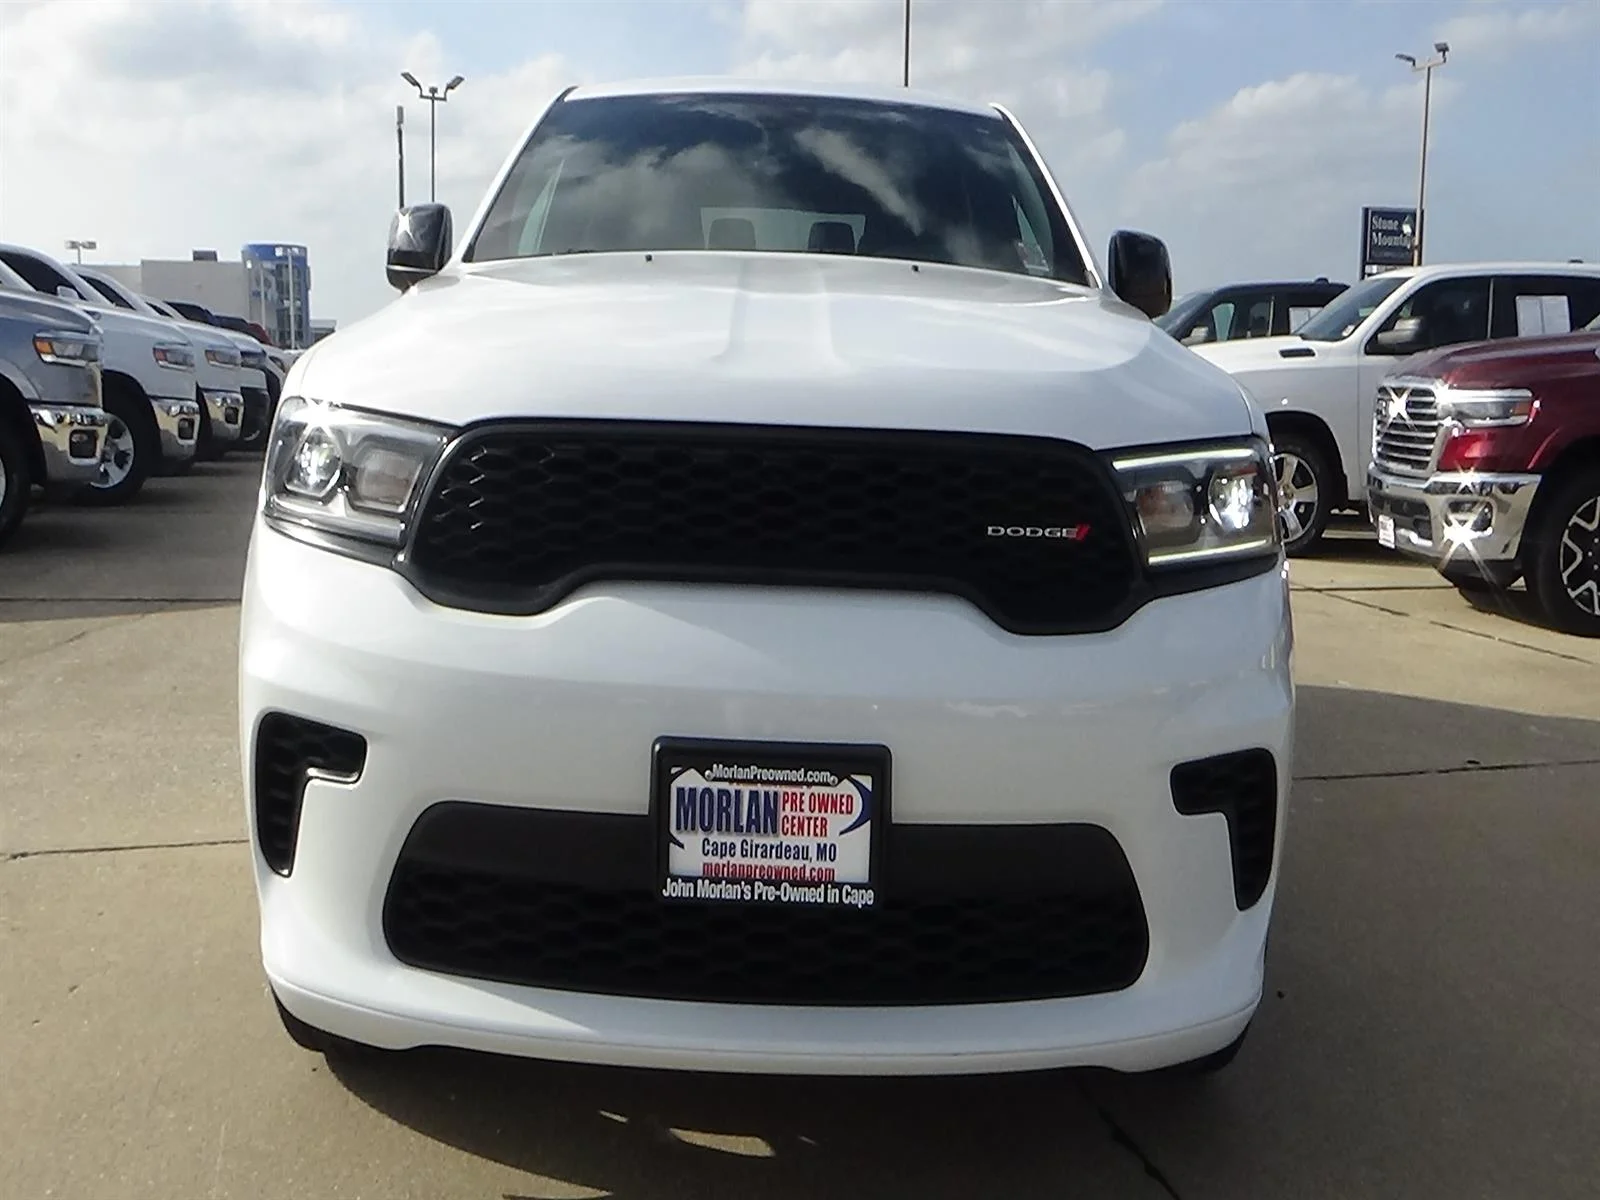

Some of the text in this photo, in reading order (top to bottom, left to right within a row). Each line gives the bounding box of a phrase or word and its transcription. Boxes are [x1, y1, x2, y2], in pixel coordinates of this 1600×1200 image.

[1372, 215, 1399, 230] Stone
[1372, 232, 1417, 247] Mounta
[987, 526, 1078, 538] DODGE
[712, 763, 831, 783] MorlanPreowned.com
[676, 787, 778, 834] MORLAN
[782, 791, 854, 815] PRE OWNED
[781, 815, 828, 837] CENTER
[702, 838, 837, 863] Cape Girardeau, MO
[703, 860, 835, 883] morlanpreowned.com
[662, 877, 875, 909] John Morlan's Pre-Owned in Cape
